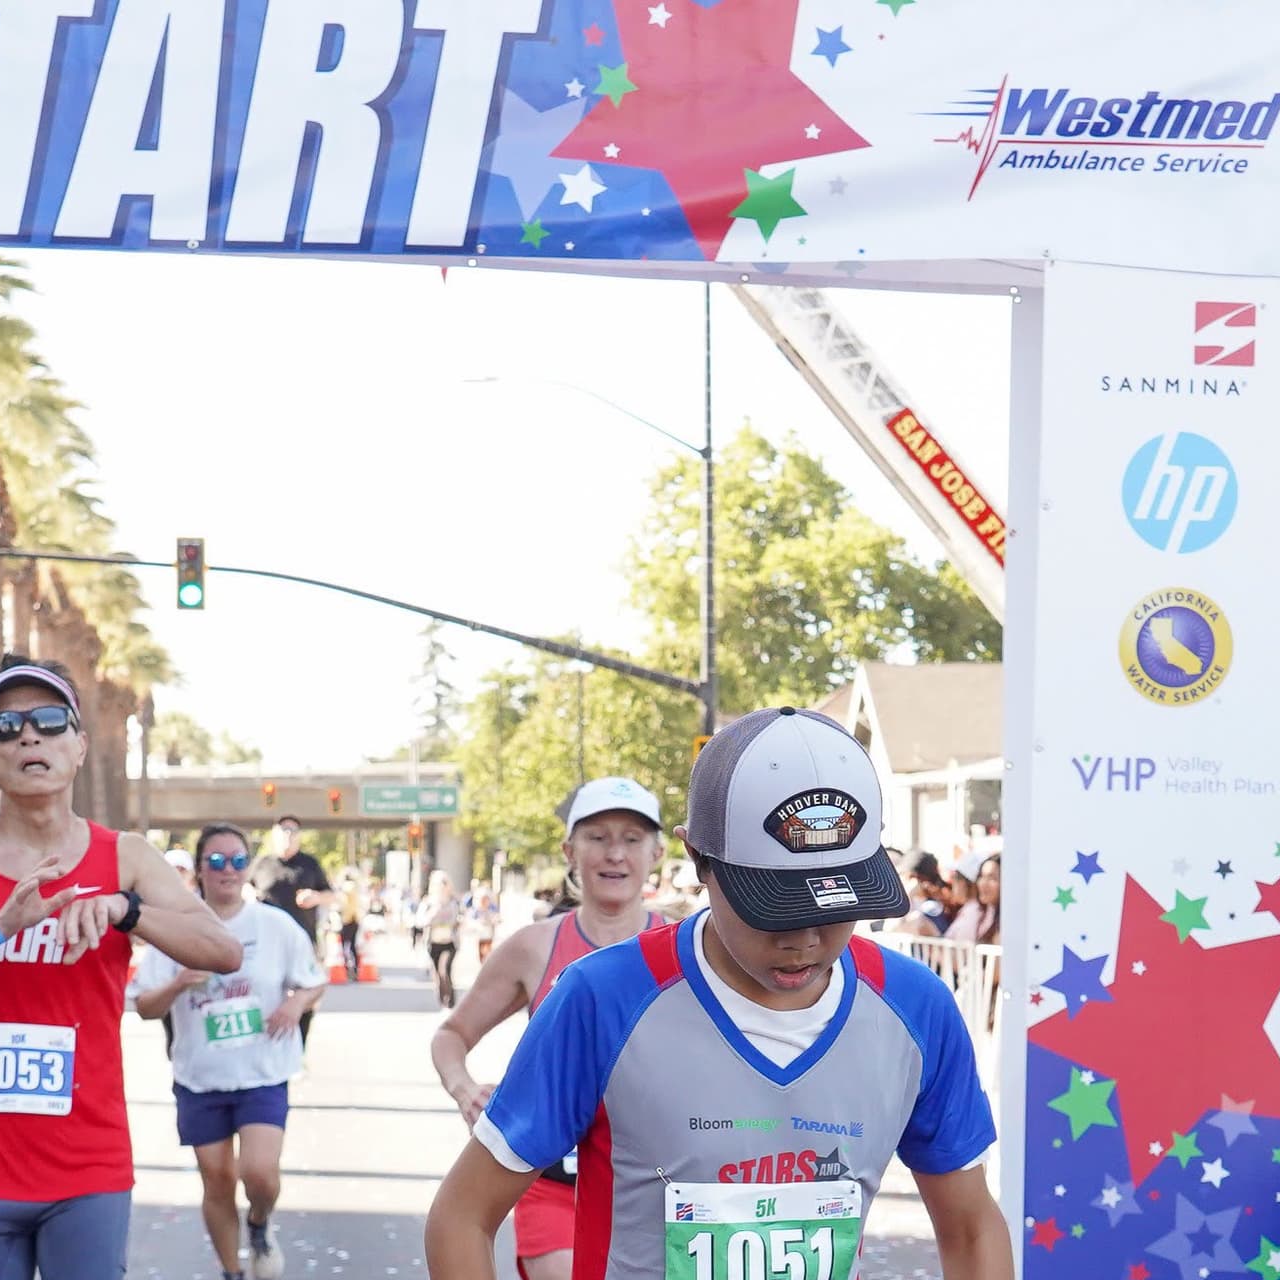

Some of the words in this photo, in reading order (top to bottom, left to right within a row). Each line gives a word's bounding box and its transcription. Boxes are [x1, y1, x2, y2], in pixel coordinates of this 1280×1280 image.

[999, 149, 1145, 171] Ambulance
[1153, 153, 1249, 174] Service
[1101, 375, 1241, 396] SANMINA
[894, 415, 941, 464] SAN
[930, 460, 987, 520] JOSE
[976, 513, 1006, 556] FI
[1133, 431, 1230, 553] hp
[1133, 591, 1220, 622] CALIFORNIA
[1127, 664, 1166, 702] WATER
[1173, 665, 1225, 702] SERVICE
[1072, 755, 1156, 792] VHP
[1167, 757, 1222, 774] Valley
[1165, 778, 1227, 795] Health
[1233, 779, 1275, 795] Plan
[777, 793, 829, 821] HOOVER
[834, 795, 858, 816] DAM
[215, 1012, 253, 1038] 211
[819, 1162, 840, 1176] AND
[755, 1198, 777, 1217] 5K
